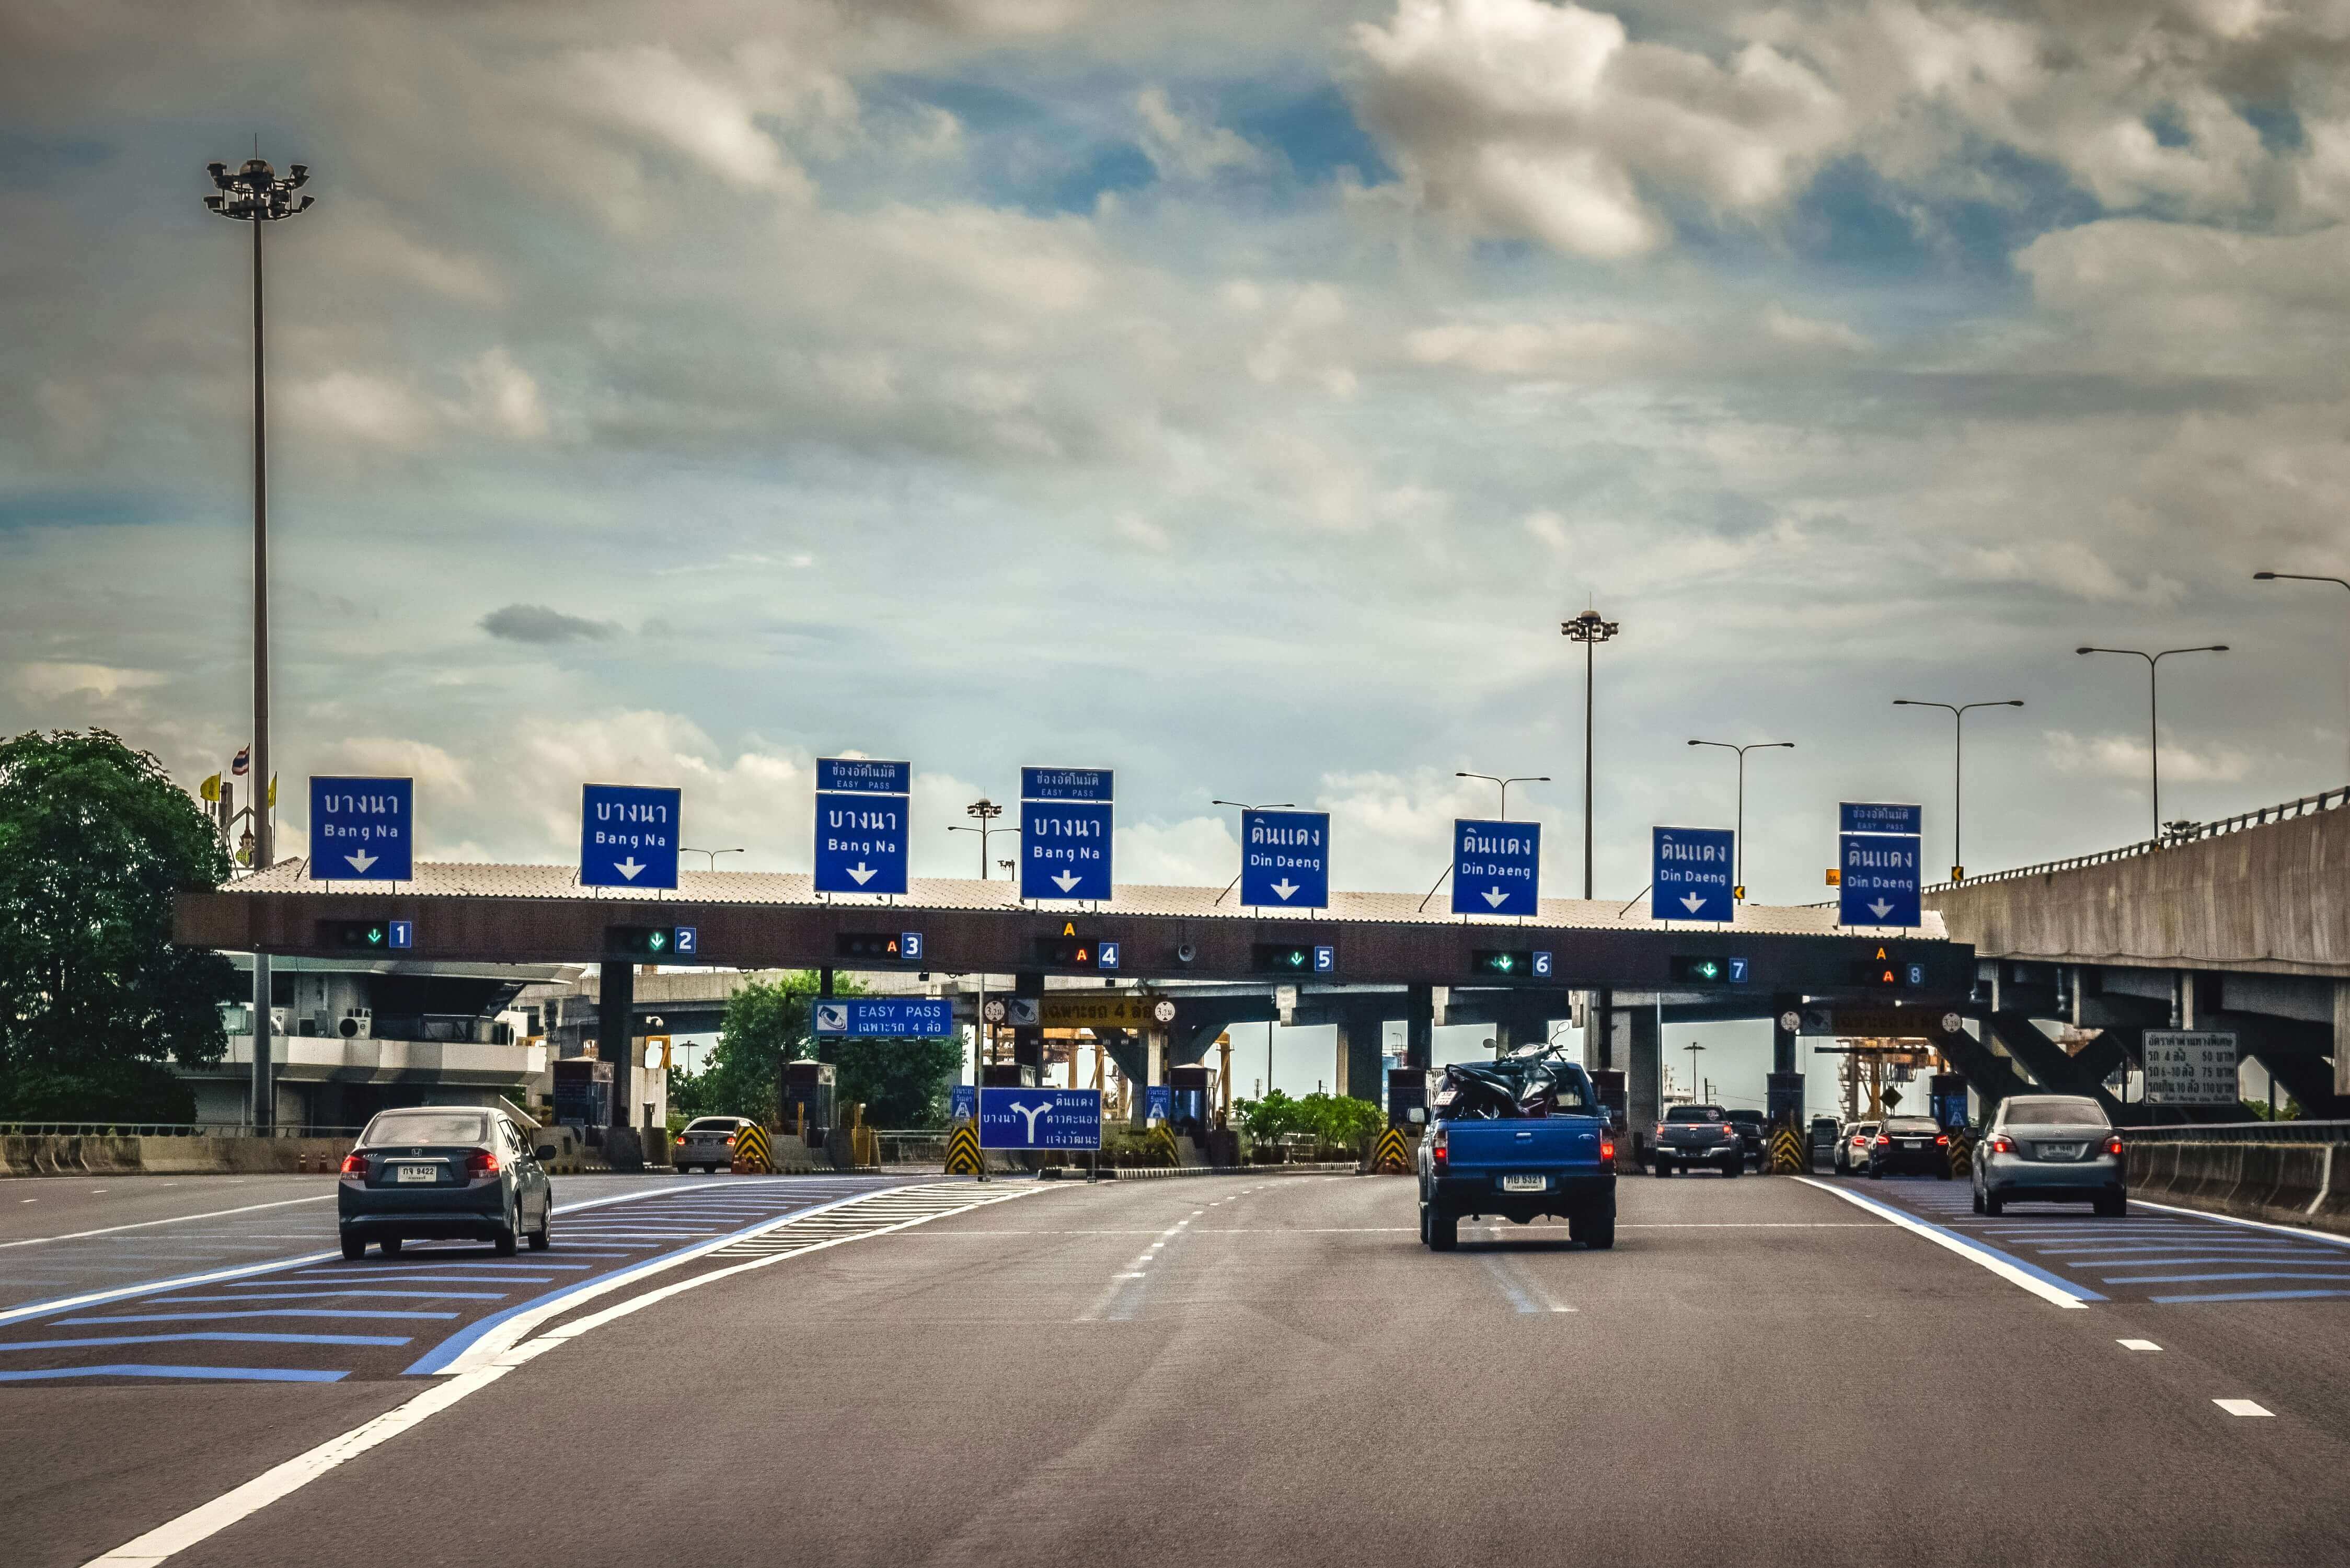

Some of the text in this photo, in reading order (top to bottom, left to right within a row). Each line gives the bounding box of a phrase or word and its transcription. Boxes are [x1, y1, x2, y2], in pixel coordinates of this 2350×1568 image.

[832, 764, 895, 778] ช่องอัตโนมัติ
[1037, 771, 1099, 786] ช่องอัตโนมัติ
[325, 795, 398, 814] บางนา
[597, 802, 666, 823] บางนา
[830, 810, 896, 830] บางนา
[1034, 818, 1100, 837] บางนา
[325, 824, 398, 841] Bang Na
[596, 831, 665, 849] Bang Na
[1252, 818, 1319, 846] ดินแดง
[828, 838, 895, 855] Bang Na
[1464, 827, 1530, 855] ดินแดง
[1662, 835, 1725, 862] ดินแดง
[1034, 846, 1099, 862] Bang Na
[1251, 852, 1320, 871] Din Daeng
[1849, 842, 1912, 868] ดินแดง
[1462, 862, 1530, 880] Din Daeng
[1661, 868, 1725, 886] Din Daeng
[1848, 875, 1869, 887] Din
[1873, 877, 1913, 892] Daeng
[397, 925, 405, 944] 1
[679, 931, 692, 950] 2
[906, 937, 918, 954] 3
[1102, 947, 1116, 964] 4
[1318, 951, 1330, 967] 5
[1536, 956, 1548, 973] 6
[1733, 962, 1744, 978] 7
[1910, 967, 1920, 983] 8
[859, 1006, 940, 1018] EASY PASS
[1114, 1003, 1124, 1018] 4
[859, 1020, 941, 1032] เฉพาะรถ 4 ล้อ
[2148, 1051, 2158, 1061] รถ
[2165, 1051, 2170, 1060] 4
[2203, 1051, 2212, 1061] 50
[2148, 1067, 2158, 1077] รถ
[2203, 1067, 2212, 1077] 75
[1056, 1093, 1093, 1107] ดินแดง
[983, 1114, 1098, 1124] บางนา ดาวคะนอง
[1046, 1131, 1098, 1144] แจ้งวัฒนะ
